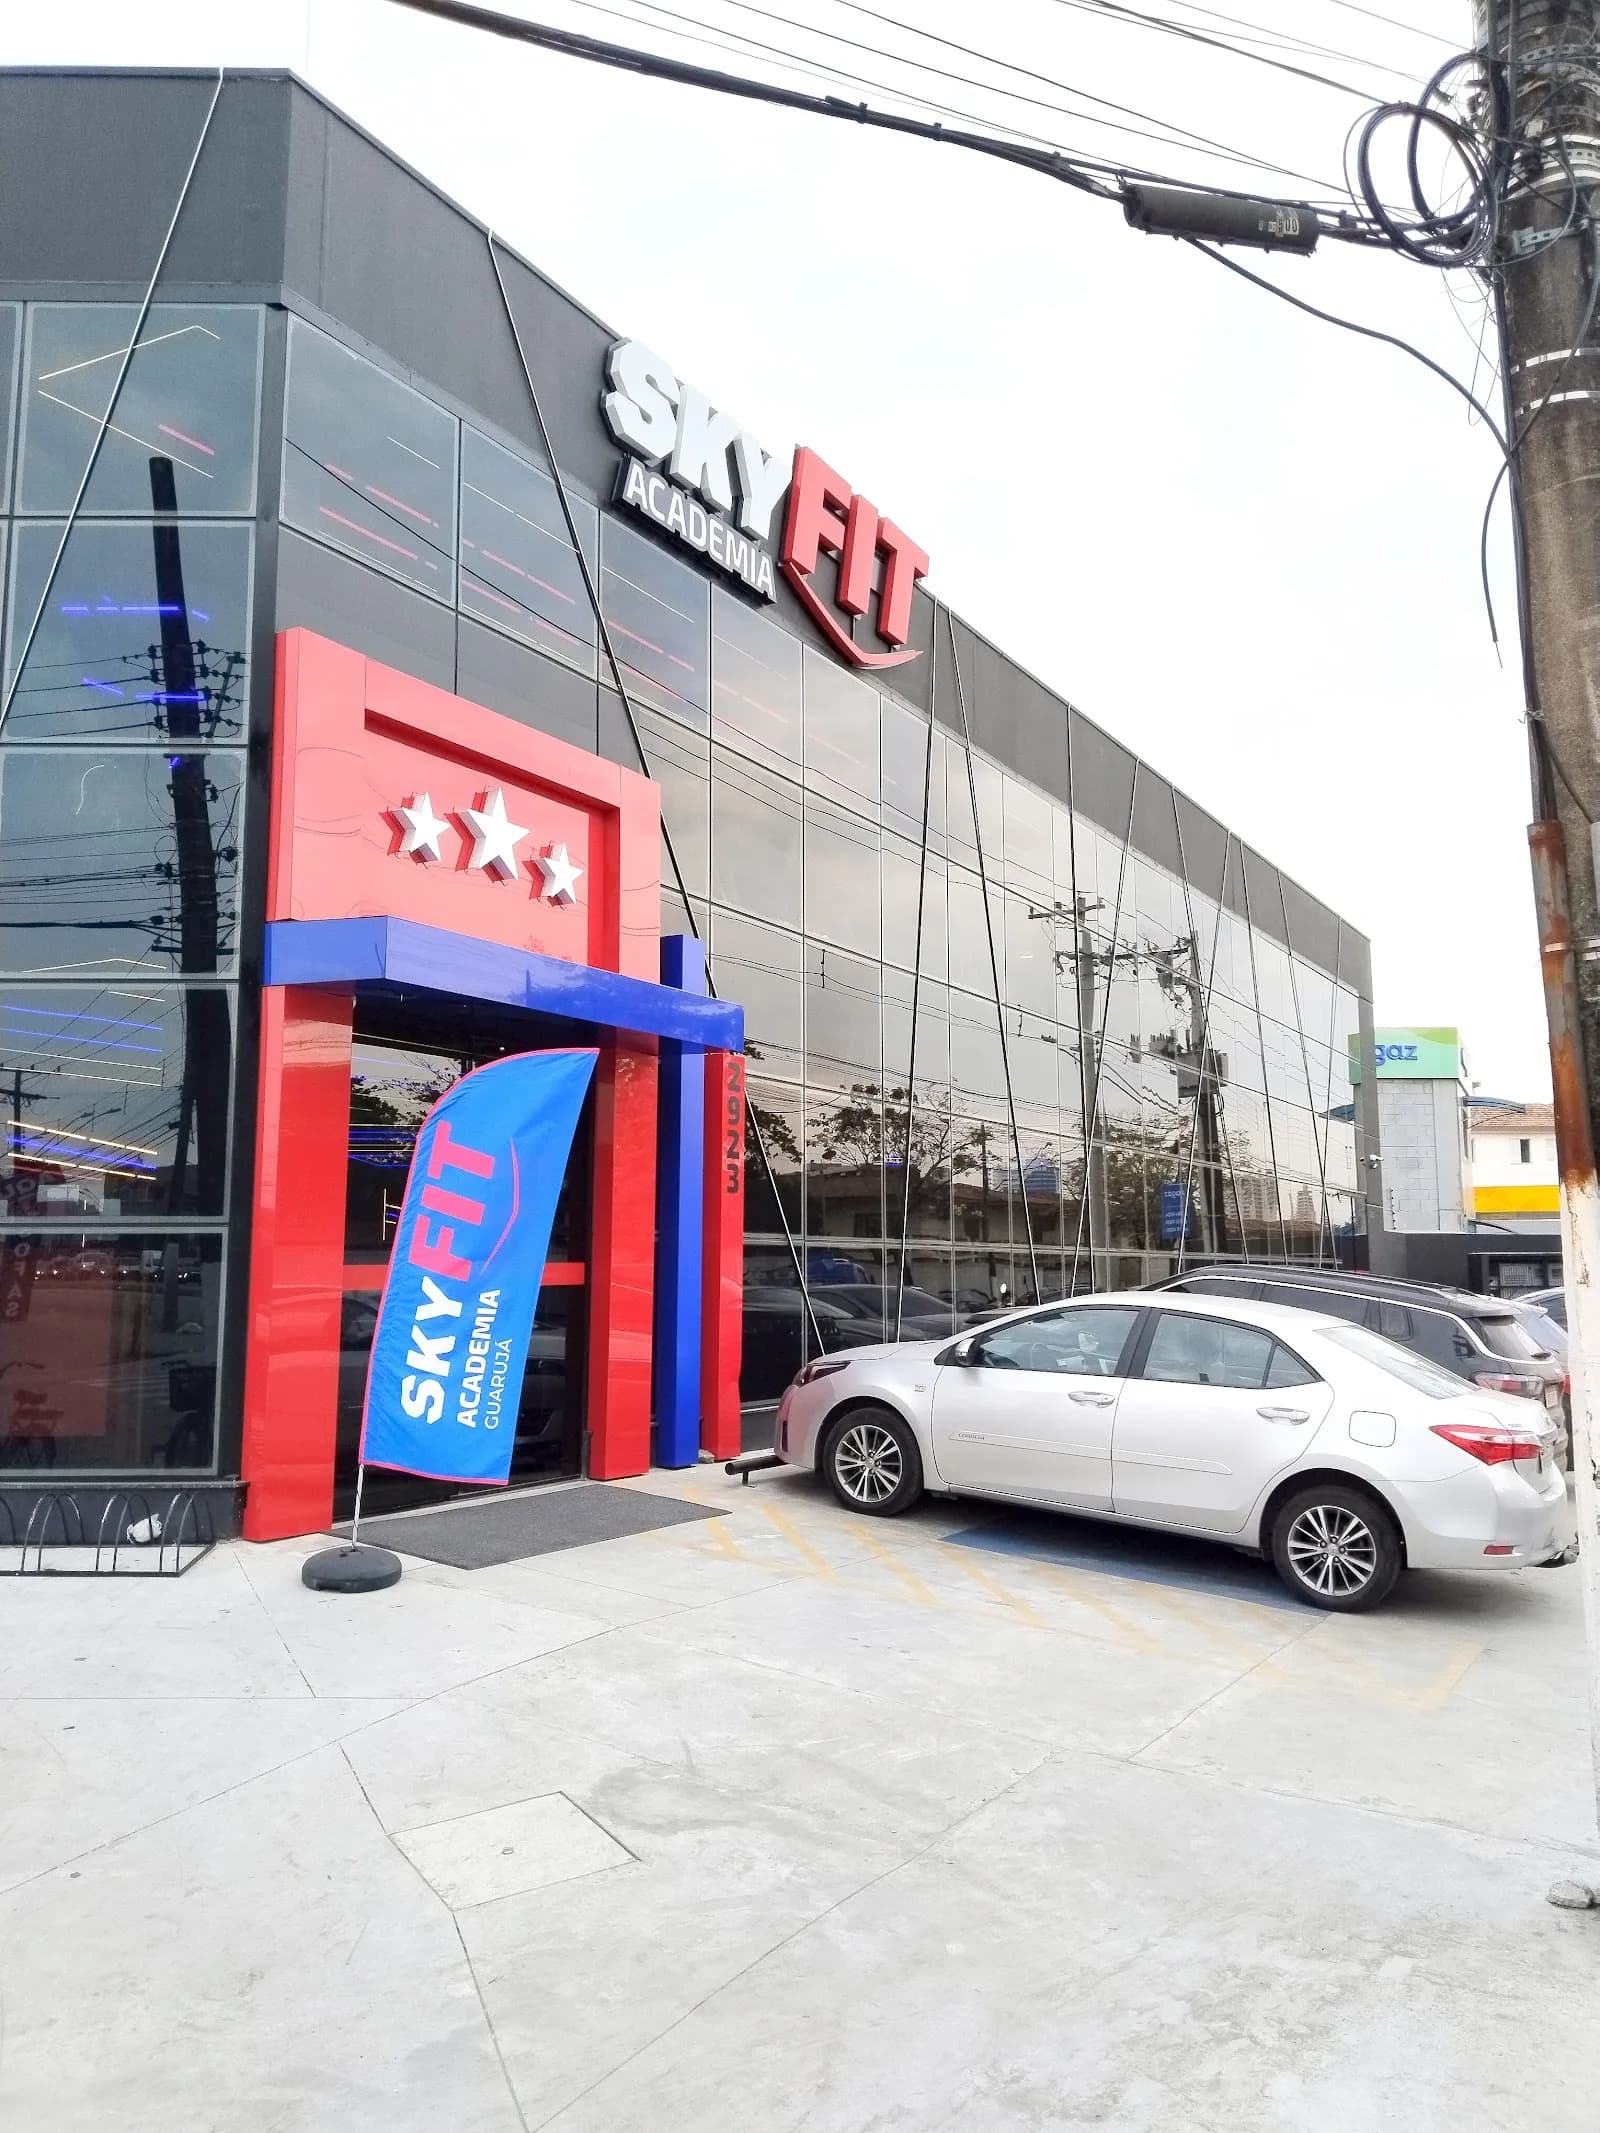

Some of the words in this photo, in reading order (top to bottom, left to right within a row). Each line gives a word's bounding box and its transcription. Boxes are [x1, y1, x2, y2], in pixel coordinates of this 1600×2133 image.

[625, 463, 775, 598] ACADEMIA
[726, 1061, 741, 1194] 2923
[456, 1288, 502, 1428] ACADEMIA
[483, 1338, 513, 1431] GUARUJÁ
